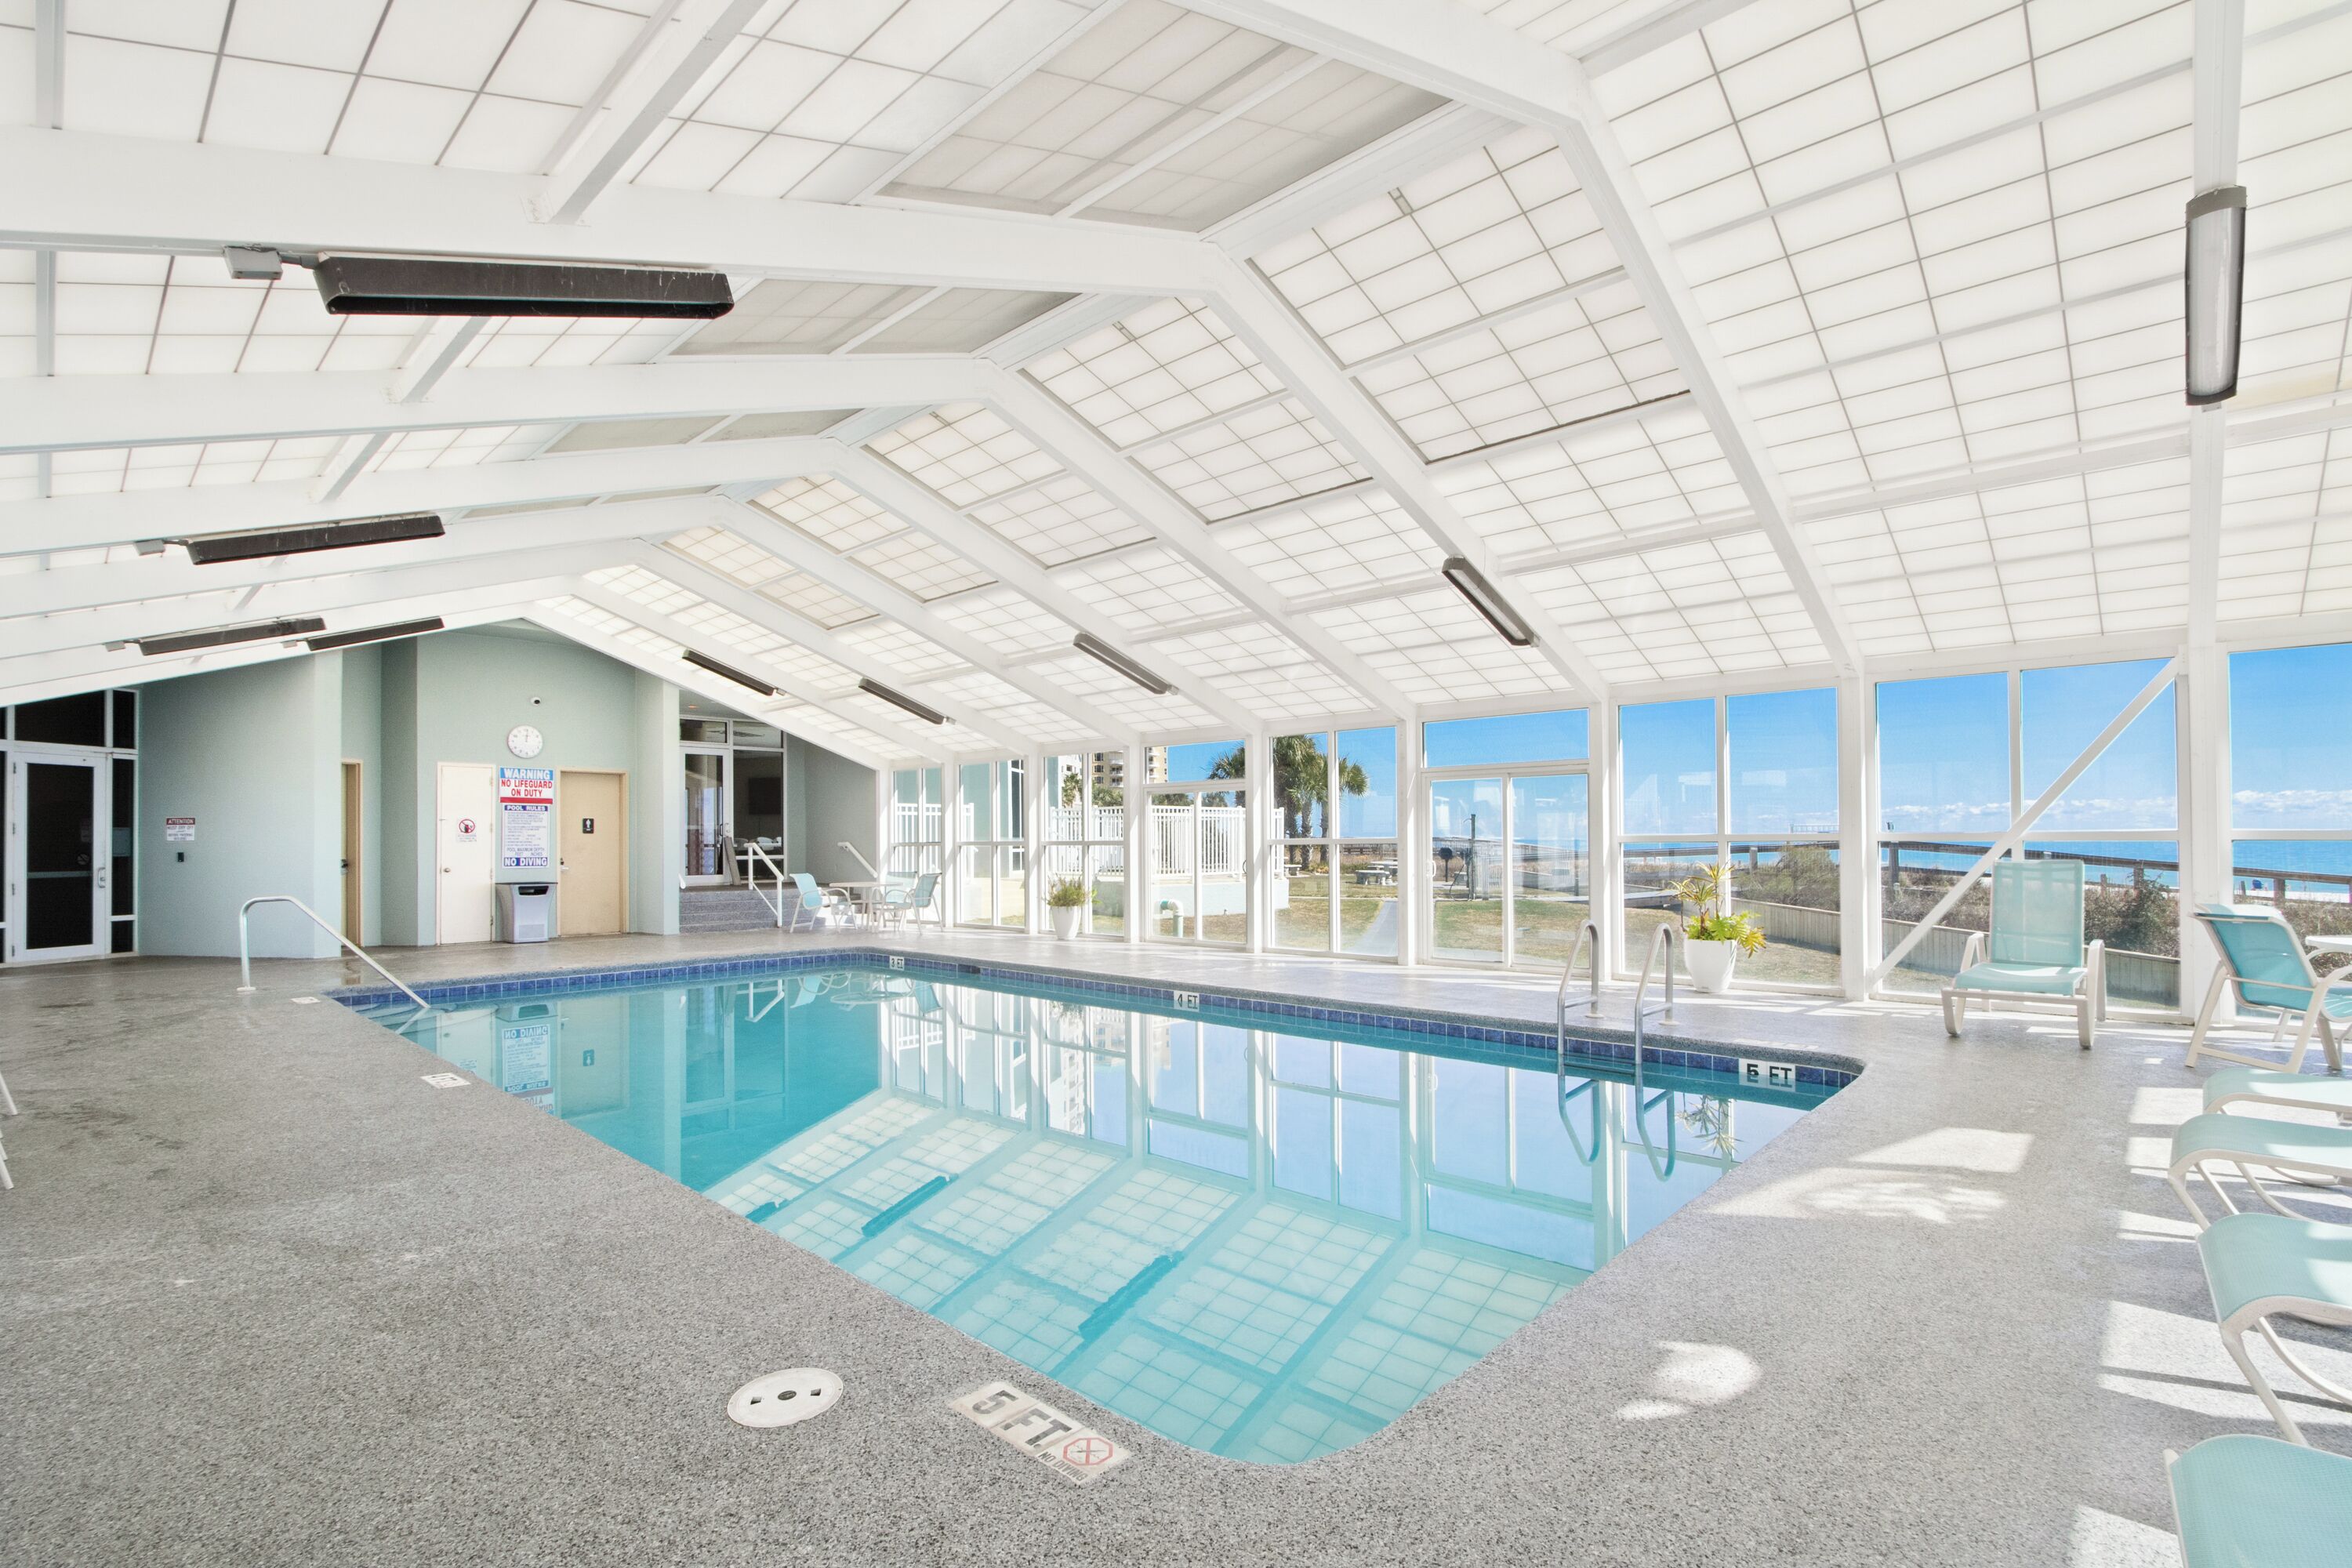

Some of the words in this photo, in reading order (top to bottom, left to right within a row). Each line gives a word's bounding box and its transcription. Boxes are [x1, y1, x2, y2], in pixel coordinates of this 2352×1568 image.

[504, 768, 550, 780] WARNING
[514, 780, 552, 789] LIFEGUARD
[505, 858, 517, 866] NO
[520, 858, 547, 866] DIVING
[1747, 1063, 1759, 1076] 5
[1769, 1065, 1791, 1080] FT
[972, 1390, 1018, 1414] 5
[1038, 1451, 1058, 1464] NO
[1053, 1460, 1088, 1481] DIVING
